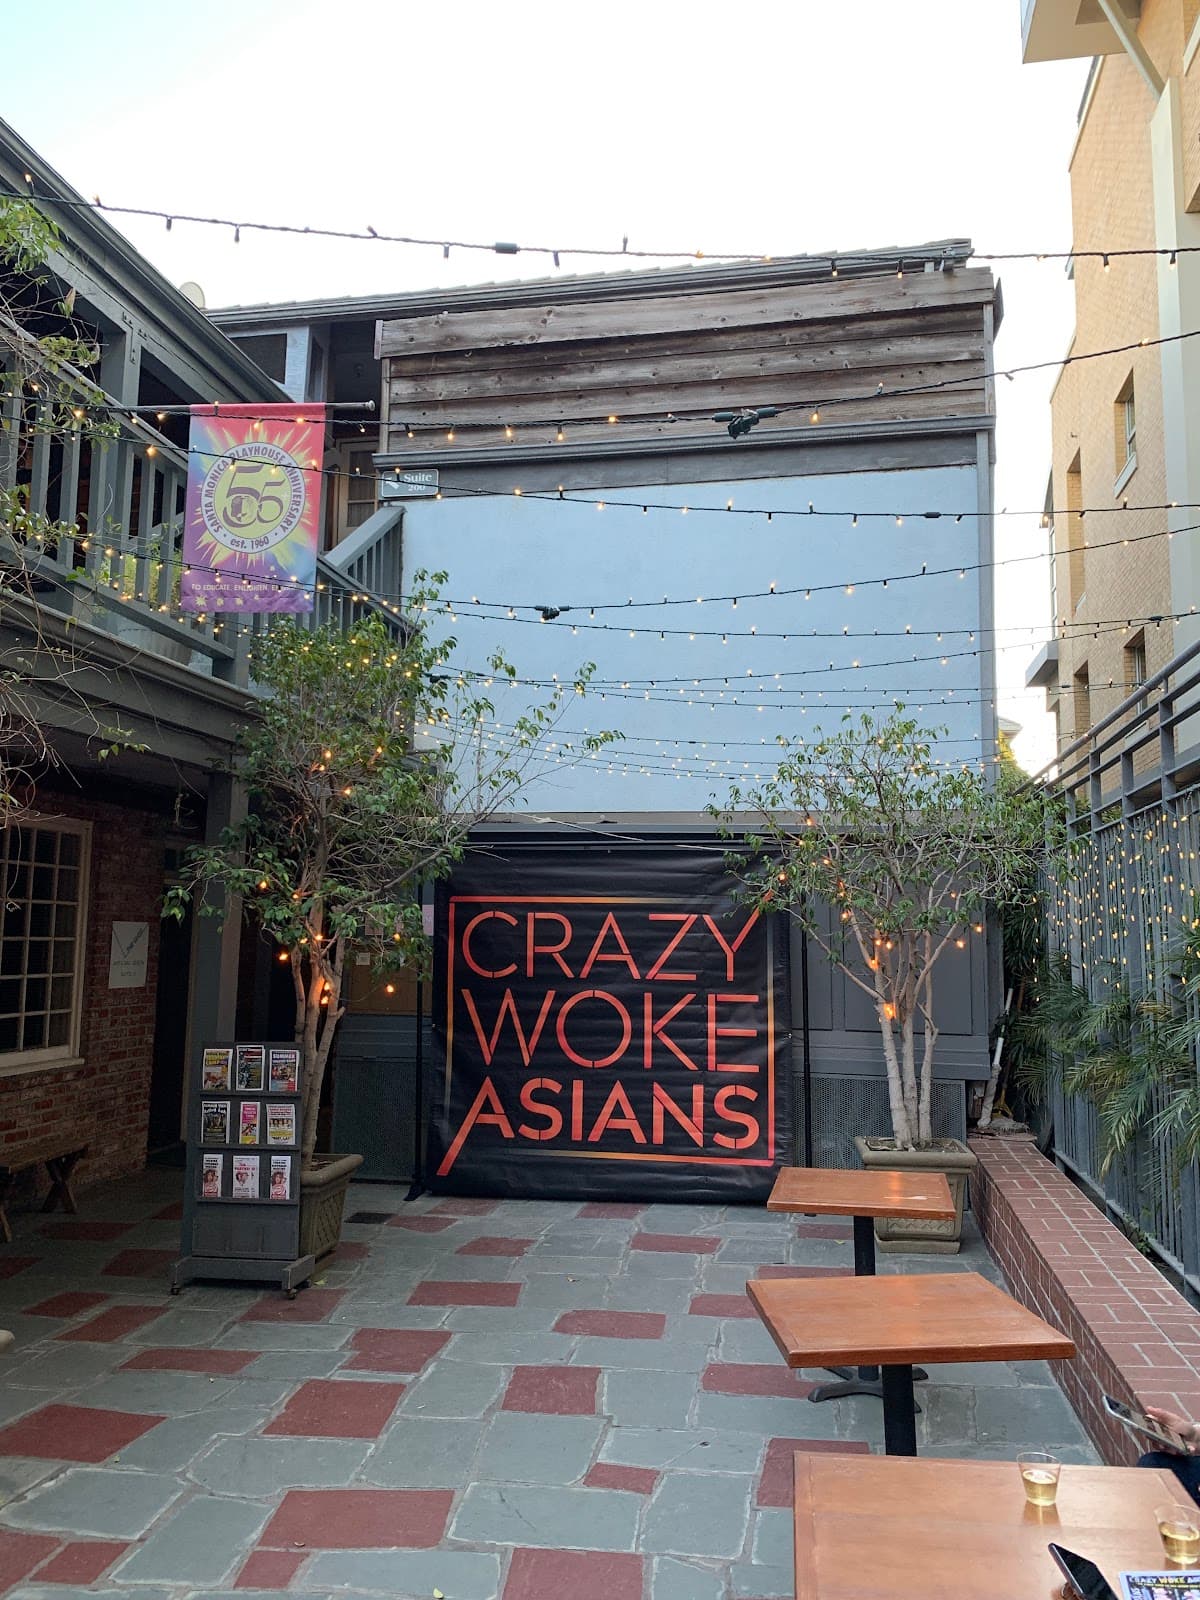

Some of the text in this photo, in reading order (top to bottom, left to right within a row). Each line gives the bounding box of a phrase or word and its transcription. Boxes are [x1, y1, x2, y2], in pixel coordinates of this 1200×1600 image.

[205, 446, 302, 533] SANTA MONICA PLAYHOUSE ANNIVERSARY
[403, 473, 432, 482] Suite
[230, 536, 270, 550] est. 1960
[462, 894, 771, 982] CRAZY
[461, 988, 759, 1072] WOKE
[436, 1076, 760, 1175] ASIANS
